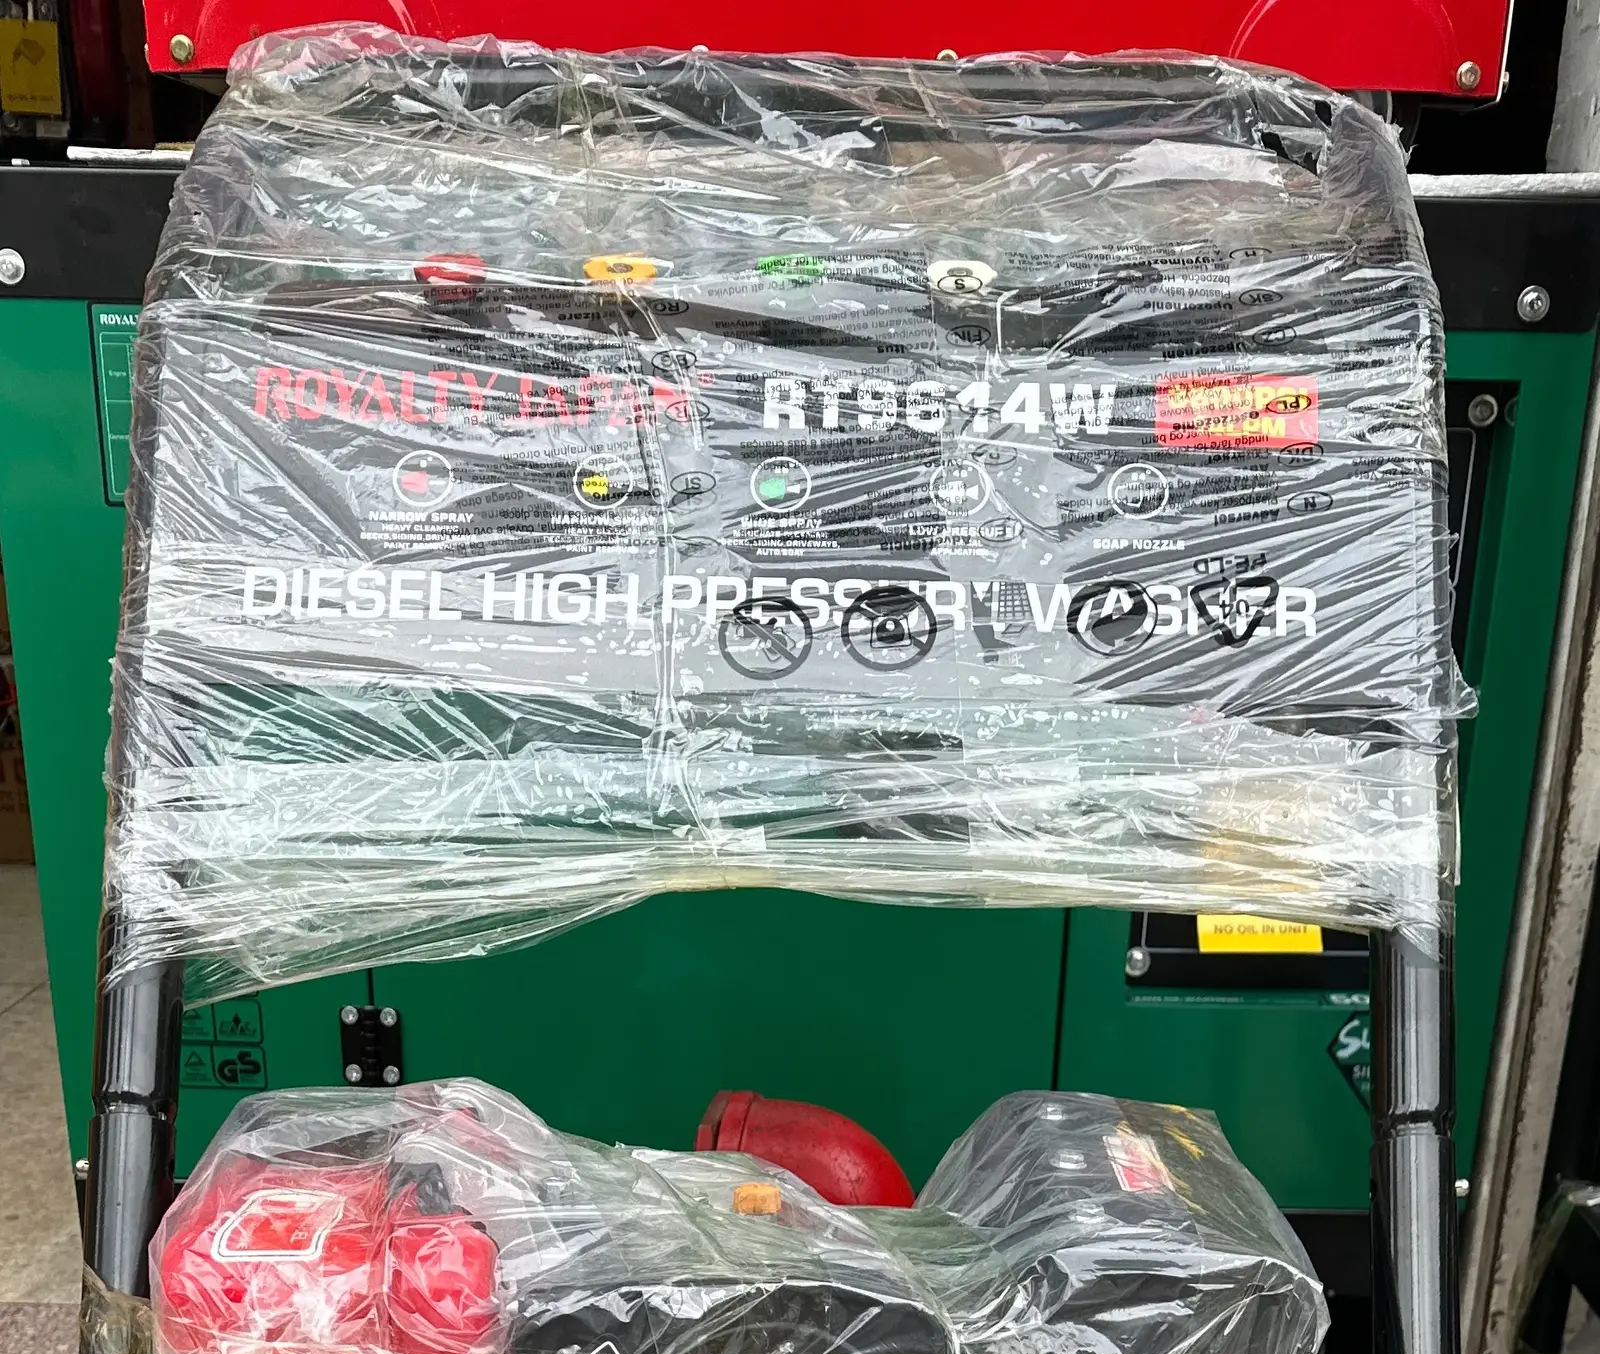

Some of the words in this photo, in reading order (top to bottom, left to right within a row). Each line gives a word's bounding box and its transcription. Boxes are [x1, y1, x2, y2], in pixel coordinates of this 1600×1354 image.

[369, 511, 428, 522] NARROW
[431, 512, 474, 522] SPRAY
[382, 524, 412, 532] HEAVY
[1092, 539, 1128, 549] SOAP
[1133, 540, 1185, 550] NOZZLE
[242, 567, 462, 621] DIESEL
[482, 570, 640, 625] HIGH
[662, 575, 1005, 632] PRESSUR
[1213, 924, 1232, 935] NO
[1237, 924, 1259, 935] OIL
[1262, 924, 1275, 934] IN
[1280, 924, 1308, 935] UNIT
